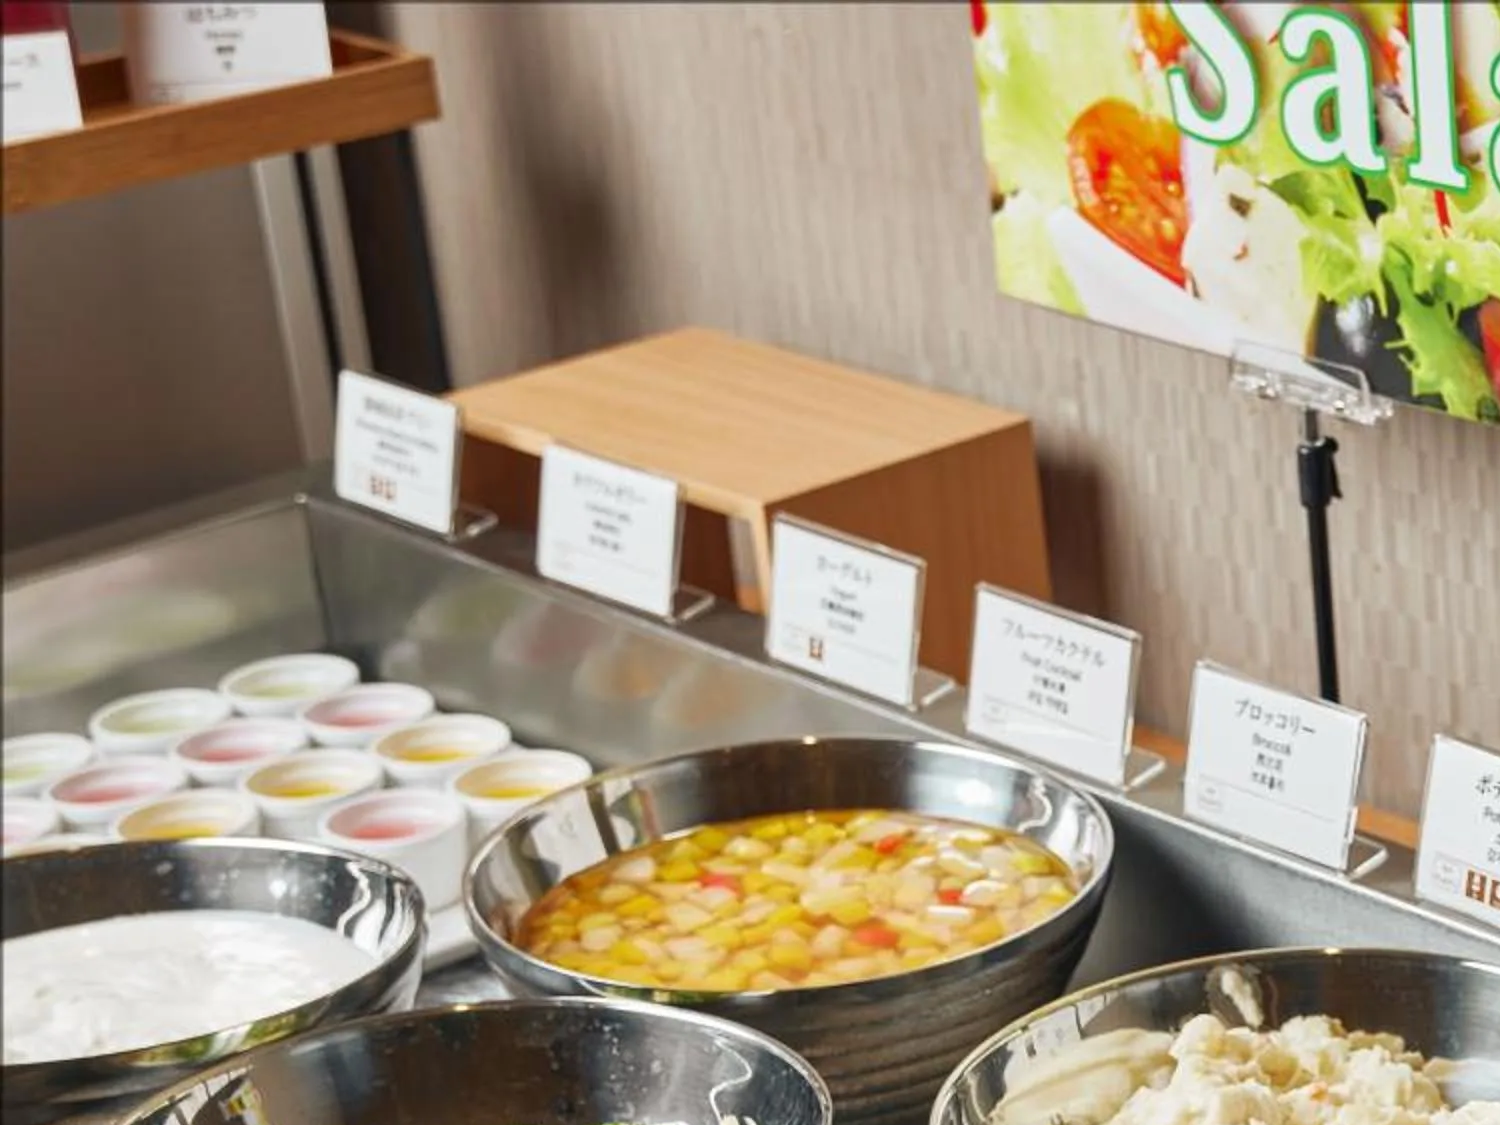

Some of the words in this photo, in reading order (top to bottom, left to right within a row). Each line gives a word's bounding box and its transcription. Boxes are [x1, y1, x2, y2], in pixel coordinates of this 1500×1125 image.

[1235, 697, 1317, 736] ブロッコリー
